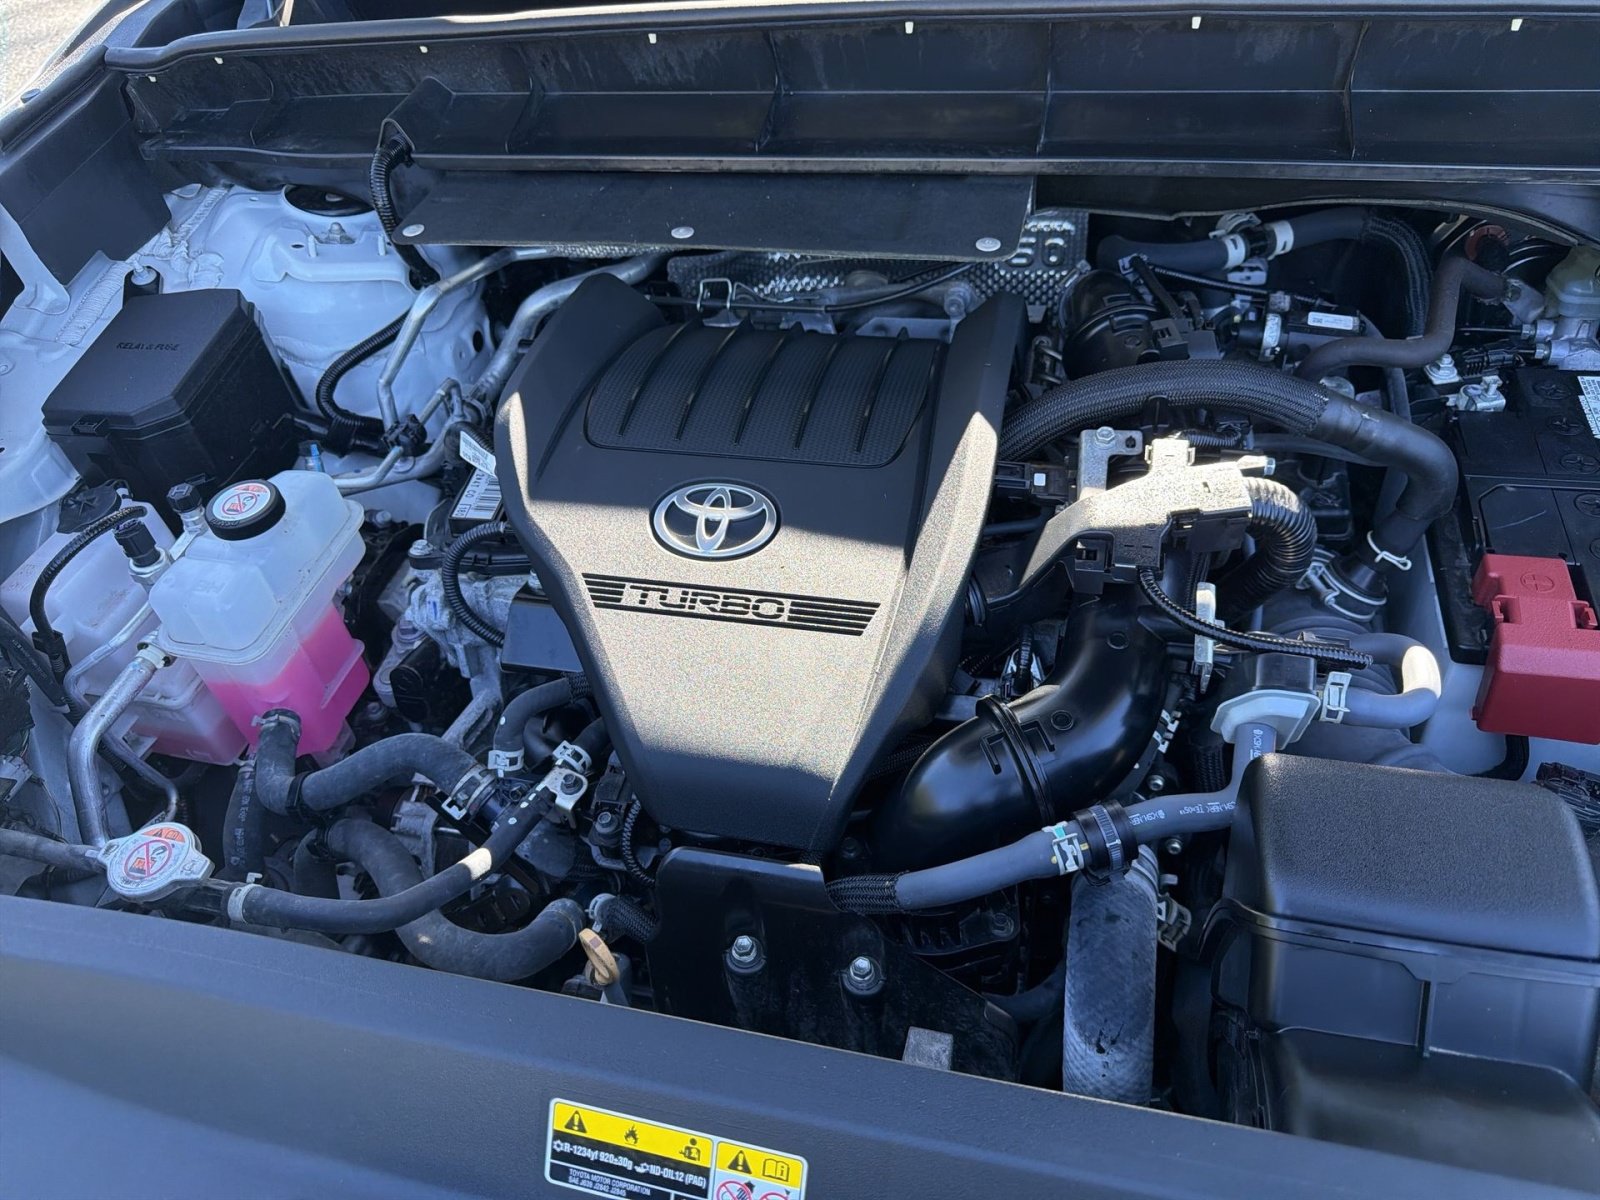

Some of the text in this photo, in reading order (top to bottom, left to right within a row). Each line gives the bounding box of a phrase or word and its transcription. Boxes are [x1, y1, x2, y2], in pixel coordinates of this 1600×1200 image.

[629, 584, 785, 620] TURBO
[564, 1142, 706, 1189] R-1234yf 920±30g ND-OIL12 (PAG)
[569, 1168, 651, 1196] TOYOTA MOTOR CORPORATION
